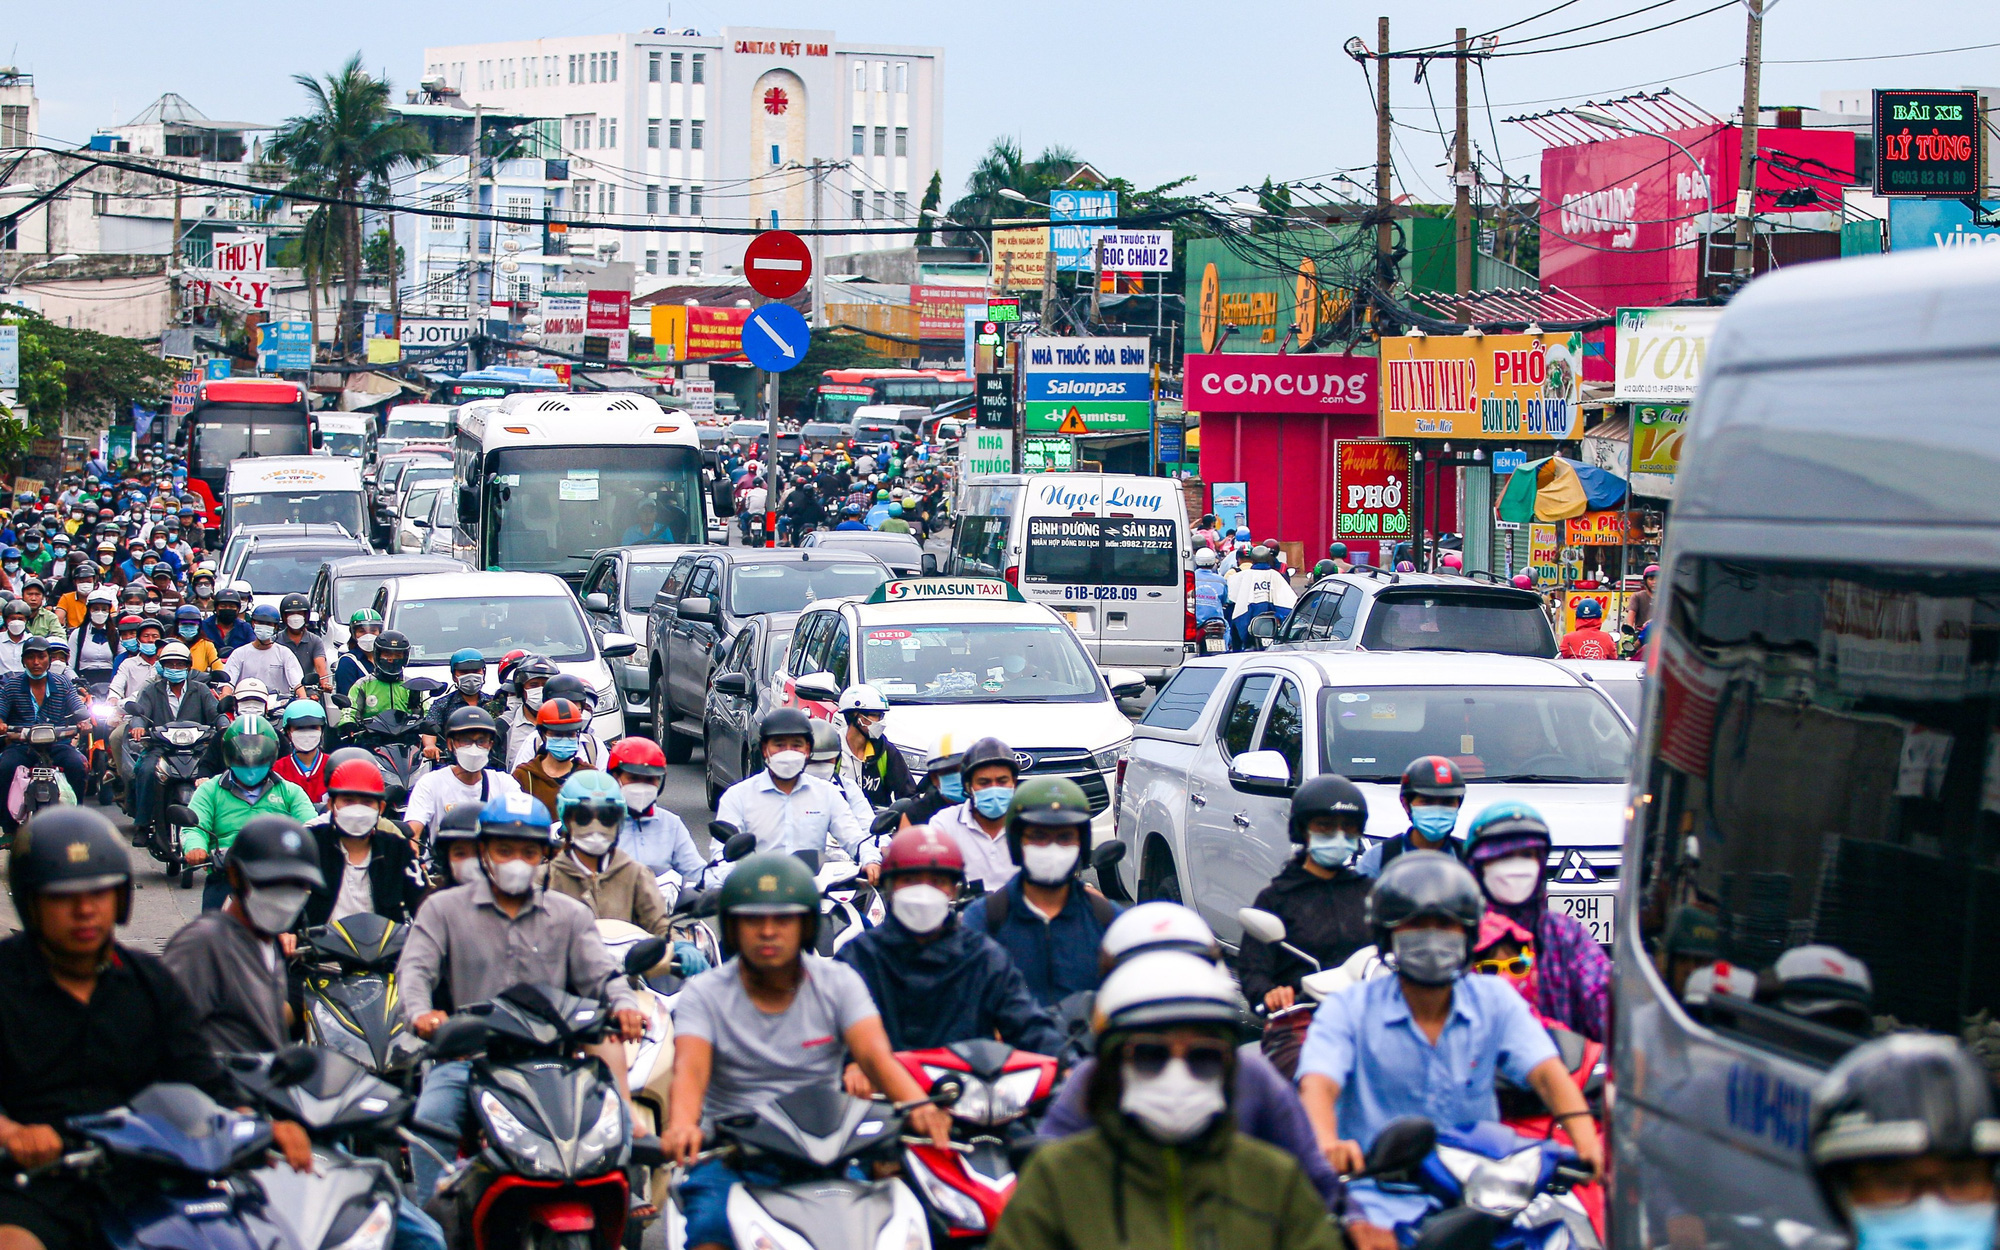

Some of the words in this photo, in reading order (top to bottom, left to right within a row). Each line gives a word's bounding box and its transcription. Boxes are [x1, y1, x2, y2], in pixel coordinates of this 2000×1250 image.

[780, 40, 801, 57] VIỆT
[806, 43, 828, 56] NAM
[1893, 101, 1930, 120] BÃI
[1934, 105, 1963, 120] XE
[1886, 128, 1913, 160] LÝ
[1916, 128, 1972, 161] TÙNG
[1159, 249, 1168, 266] 2
[1031, 345, 1053, 366] NHÀ
[1056, 343, 1090, 366] THUỐC
[1095, 344, 1116, 366] HÒA
[1120, 345, 1145, 366] BÌNH
[1494, 339, 1548, 386] PHỞ
[987, 378, 1002, 390] NHÀ
[1046, 379, 1127, 397] Salonpas
[1201, 373, 1368, 404] concung
[1438, 358, 1467, 413] MAI
[982, 392, 1007, 406] THUỐC
[987, 410, 1001, 422] TÂY
[1481, 390, 1503, 433] BÚN
[1505, 391, 1520, 433] BÒ
[1527, 391, 1543, 433] BÒ
[1544, 397, 1567, 433] KHO
[978, 433, 1003, 450] NHÀ
[970, 455, 1011, 474] THUỐC
[1040, 485, 1100, 511] Ngọc
[1105, 486, 1163, 512] Long
[1347, 475, 1402, 508] PHỞ
[1031, 519, 1058, 535] BÌNH
[1062, 520, 1100, 537] DƯƠNG
[1122, 521, 1146, 538] SÂN
[1149, 524, 1172, 538] BAY
[1341, 508, 1378, 533] BÚN
[1382, 508, 1407, 533] BÒ
[1078, 539, 1086, 547] DU
[1573, 533, 1592, 543] Pha
[1595, 533, 1619, 543] Phin
[913, 584, 975, 596] VINASUN
[977, 583, 1002, 595] TAXI
[1065, 585, 1138, 601] 61B-028.09
[1564, 898, 1599, 919] 29H
